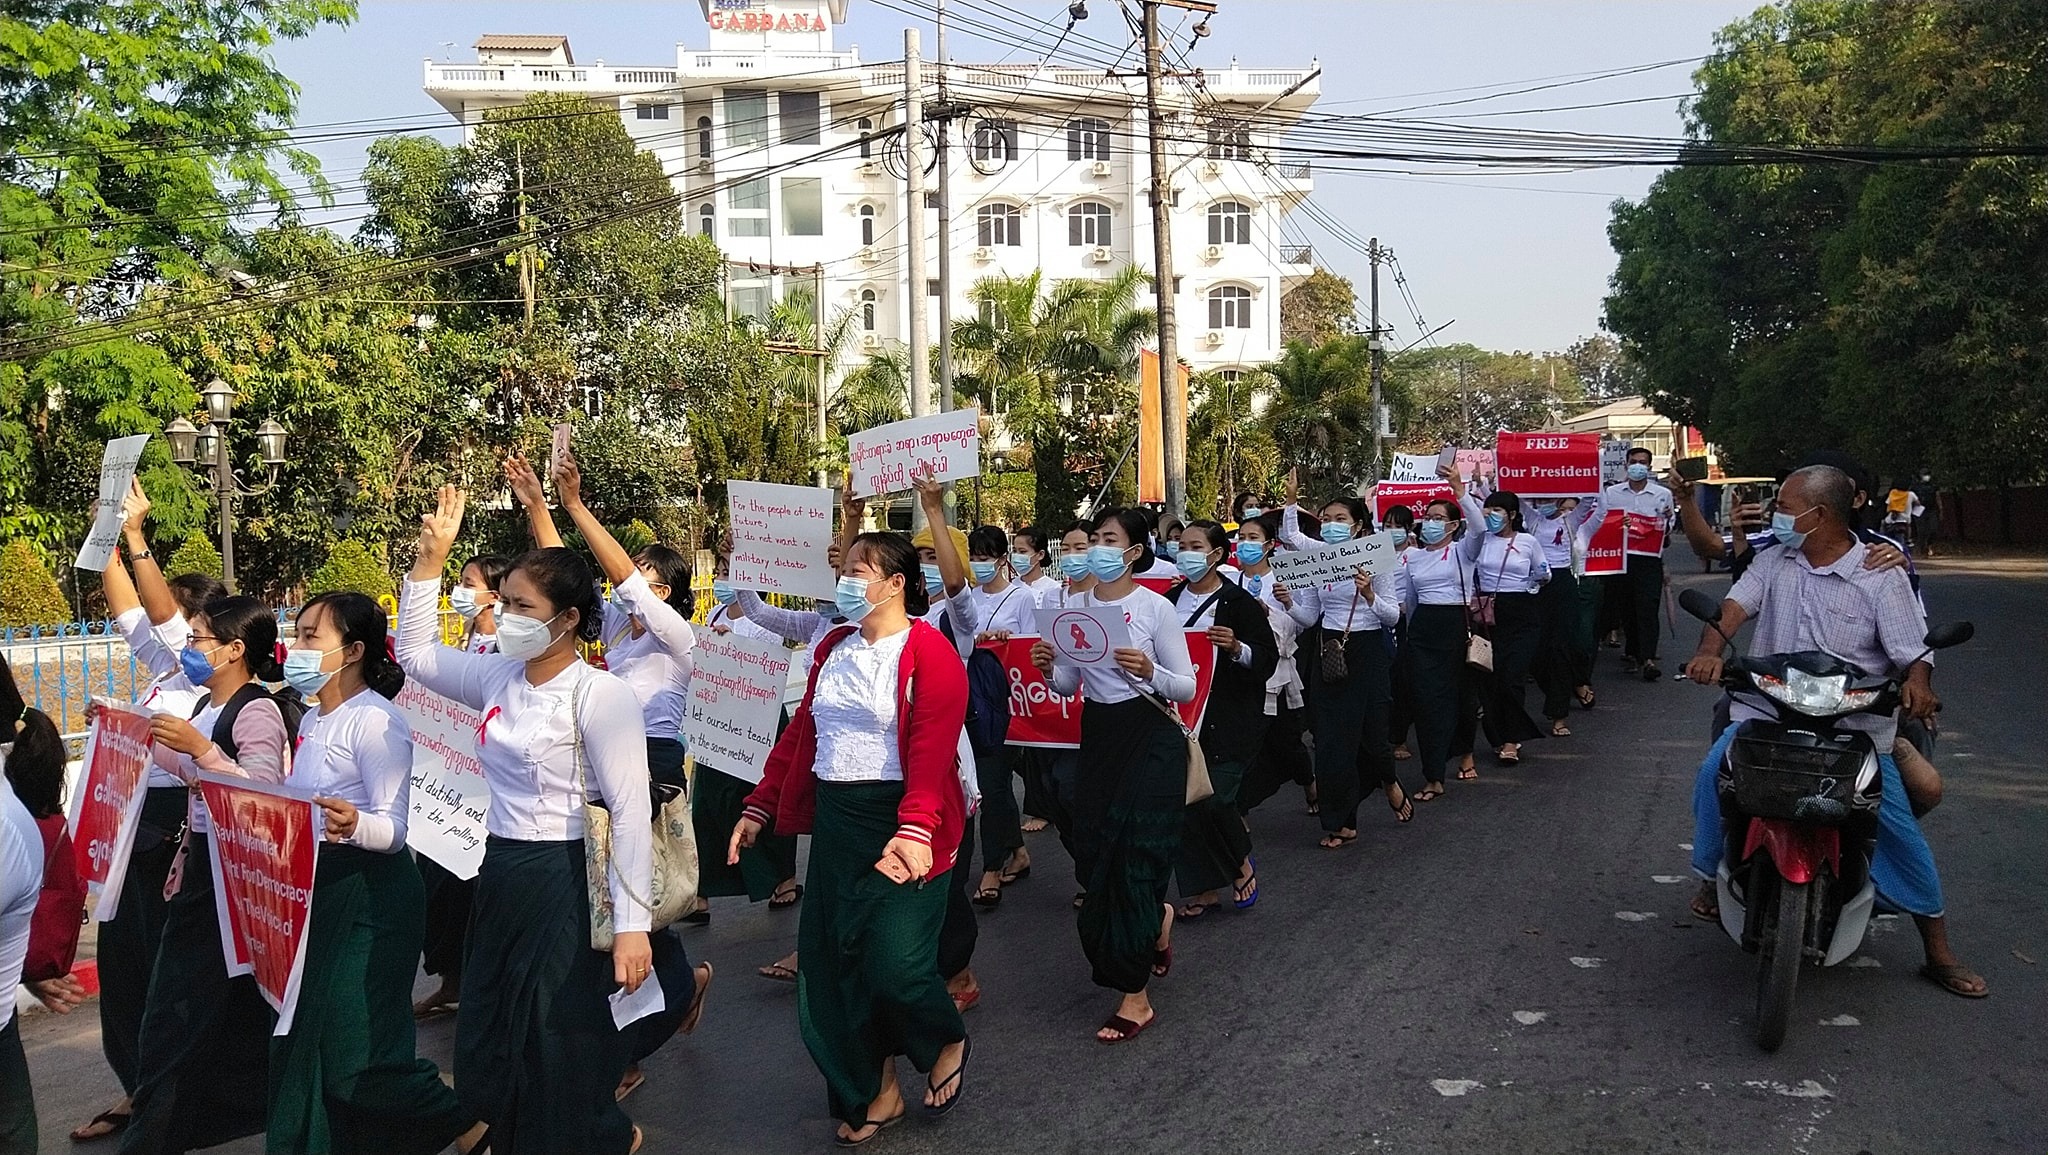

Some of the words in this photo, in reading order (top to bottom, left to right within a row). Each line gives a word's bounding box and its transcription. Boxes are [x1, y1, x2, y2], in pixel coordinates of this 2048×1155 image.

[708, 11, 826, 31] GABBANA
[1525, 437, 1570, 450] FREE
[1394, 455, 1414, 470] No
[1499, 466, 1527, 478] Our
[1531, 465, 1598, 477] President
[732, 495, 746, 509] For
[750, 498, 765, 513] the
[768, 505, 791, 519] people
[794, 506, 803, 516] of
[809, 508, 825, 519] the
[734, 514, 768, 529] future,
[734, 528, 741, 538] I
[744, 530, 755, 541] do
[759, 533, 773, 543] not
[775, 537, 797, 547] want
[735, 552, 770, 569] military
[775, 557, 807, 570] dictator
[1271, 561, 1288, 570] We
[1294, 555, 1316, 567] Don't
[1320, 551, 1337, 561] Pull
[1340, 546, 1360, 557] Back
[1365, 543, 1382, 551] Our
[1586, 547, 1622, 558] sident
[735, 569, 752, 583] like
[759, 572, 782, 587] this.
[1276, 572, 1309, 583] Children
[1312, 567, 1327, 576] into
[1332, 565, 1347, 574] the
[1287, 580, 1316, 591] ithout
[692, 704, 704, 721] let
[706, 716, 742, 736] ourselves
[747, 726, 772, 747] teach
[689, 734, 696, 744] in
[698, 732, 710, 750] the
[710, 743, 727, 755] same
[727, 749, 755, 766] method
[425, 778, 463, 815] dutifully
[465, 808, 486, 823] and
[413, 802, 422, 813] in
[427, 807, 445, 825] the
[442, 825, 480, 850] polling
[283, 918, 293, 937] of
